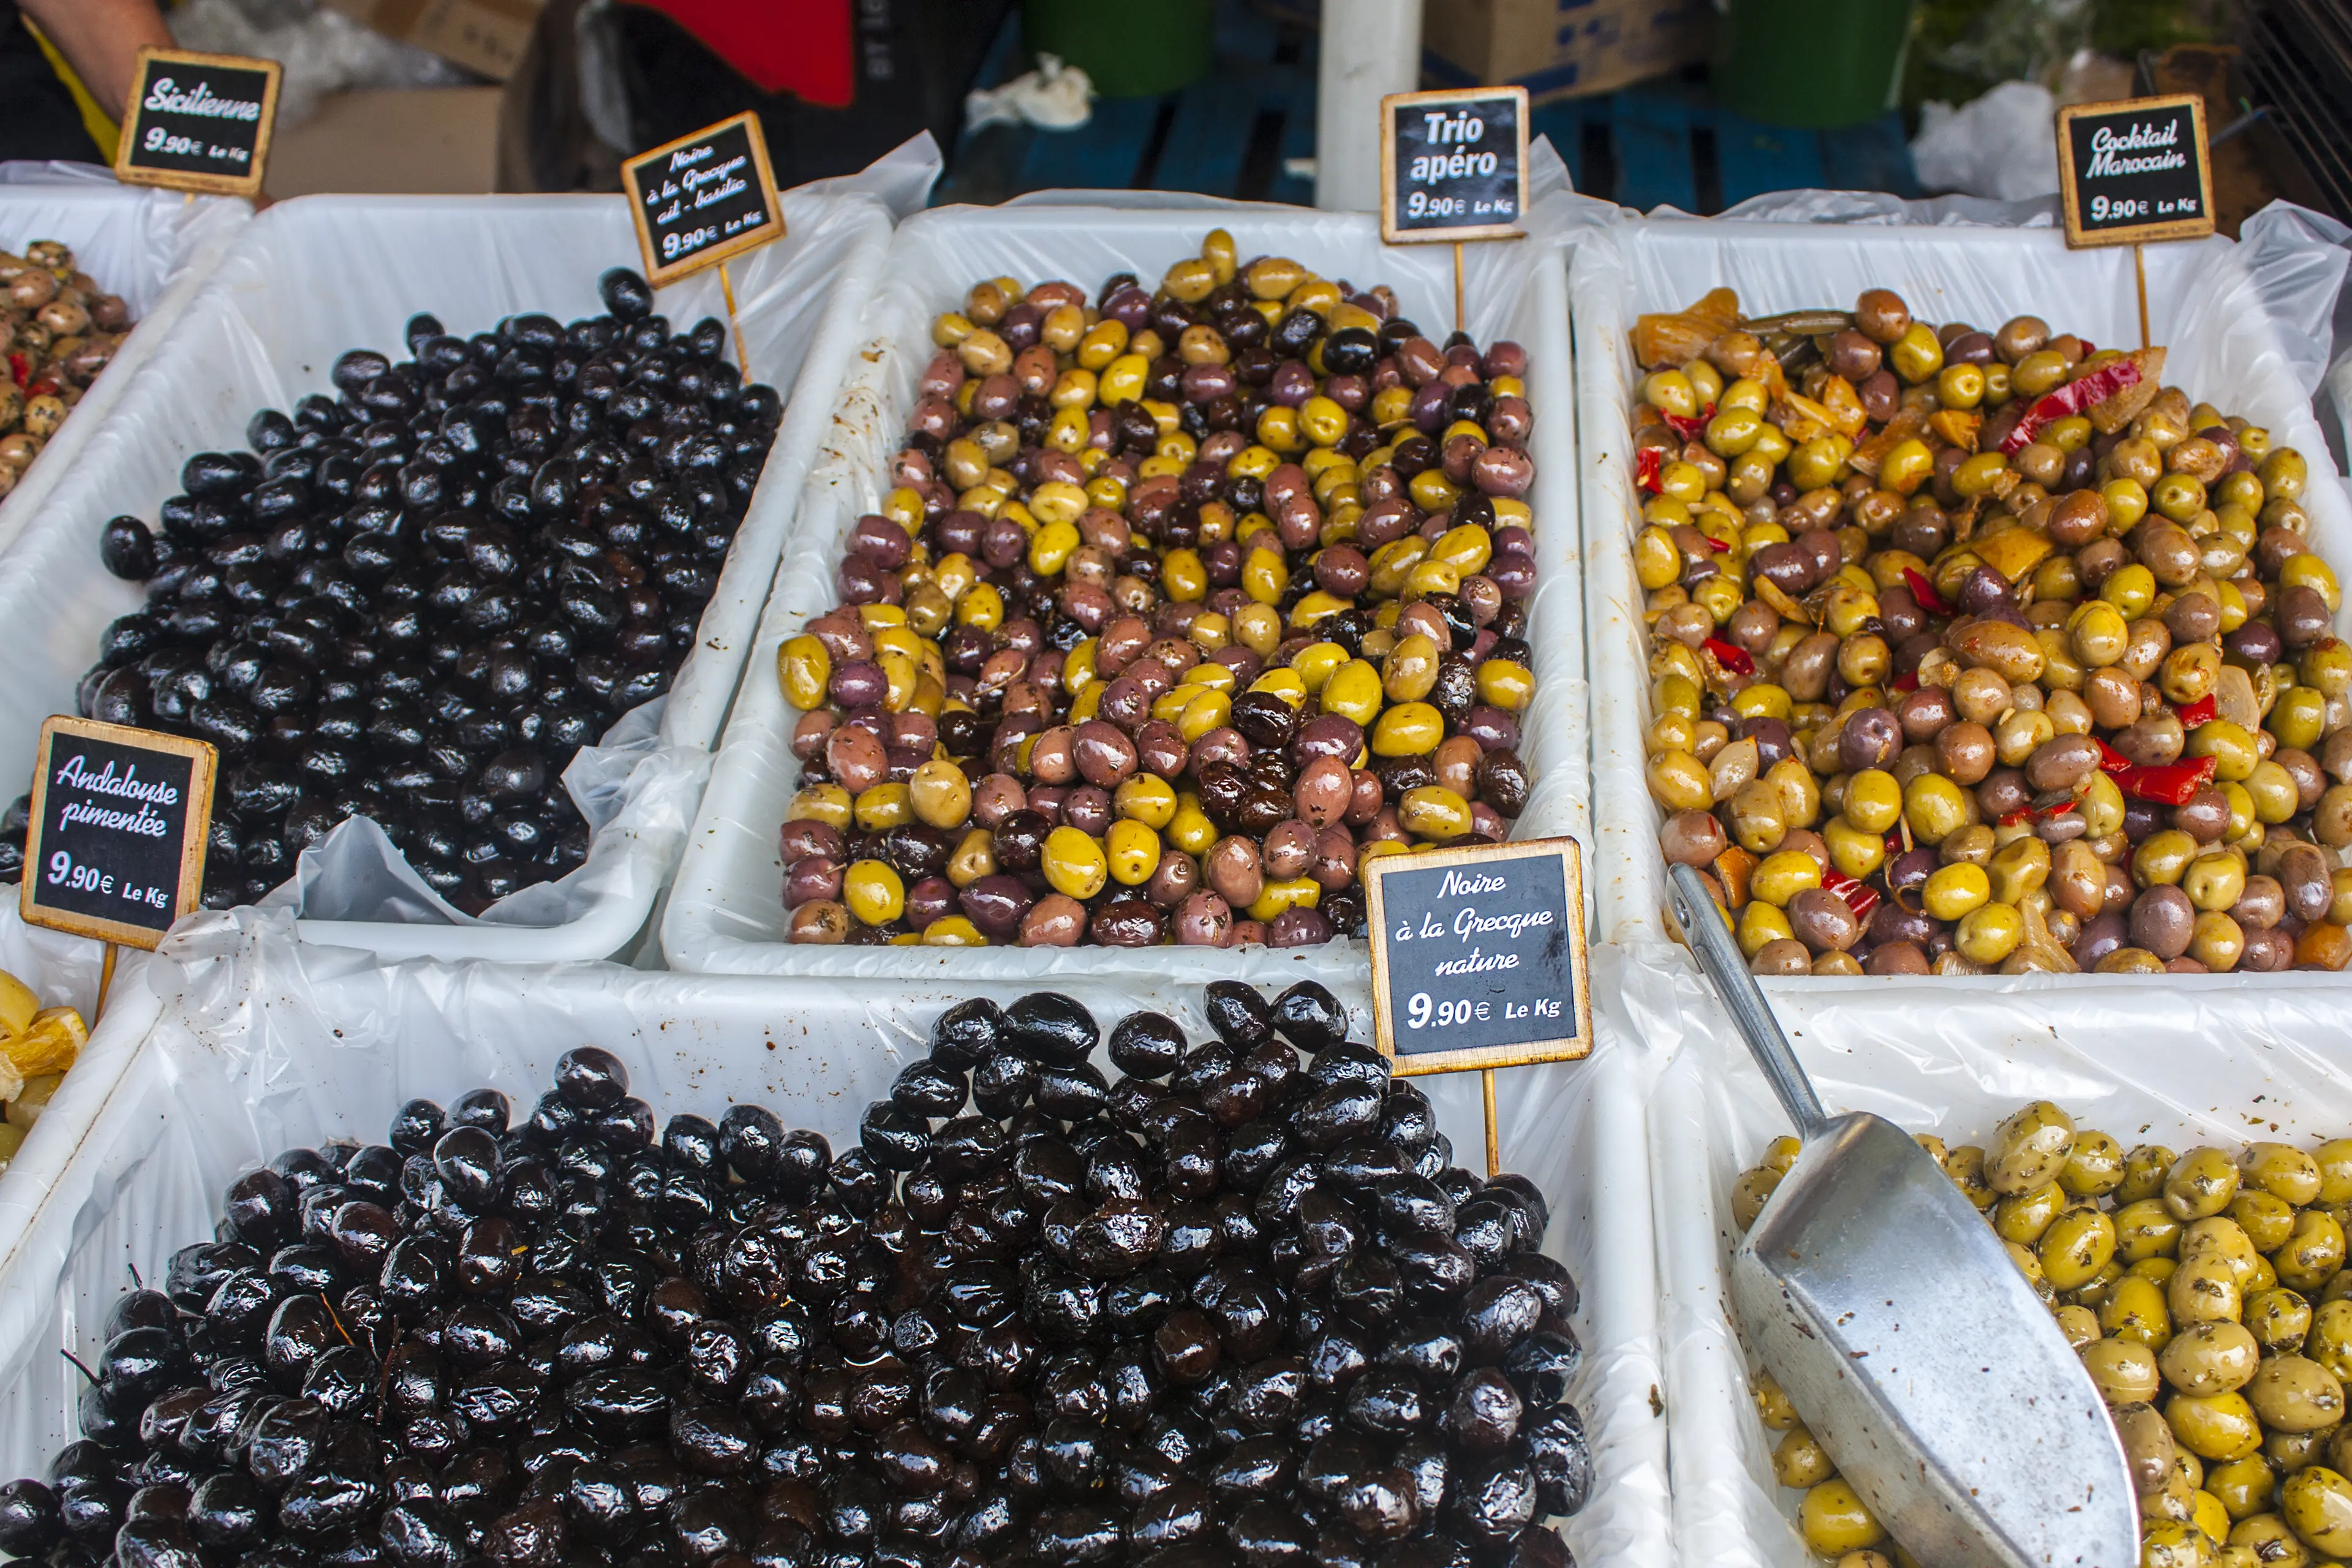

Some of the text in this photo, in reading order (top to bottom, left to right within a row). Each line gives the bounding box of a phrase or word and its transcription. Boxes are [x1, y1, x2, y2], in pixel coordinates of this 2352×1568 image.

[144, 77, 260, 121] Sicilienne
[144, 127, 249, 162] 9.90€ Le Kg
[1424, 110, 1484, 145] Trio
[2091, 118, 2177, 153] Cocktail
[669, 145, 714, 173] Noire
[1410, 145, 1497, 185] apéro
[2085, 149, 2186, 179] Marocain
[646, 156, 747, 206] à la Grecque
[657, 199, 681, 225] ail
[695, 178, 748, 209] basilic
[1408, 191, 1513, 219] 9.90€ Le Kg
[2091, 195, 2196, 221] 9.90€ Le Kg
[663, 211, 762, 258] 9.90€ Le Kg
[57, 755, 178, 805] Andalouse
[59, 799, 167, 837] pimentée
[48, 851, 168, 908] 9.90€ Le Kg
[1436, 870, 1506, 899] Noire
[1395, 907, 1553, 943] à la Grecque
[1435, 946, 1520, 976] nature
[1408, 992, 1561, 1030] 9.90€ Le Kg
